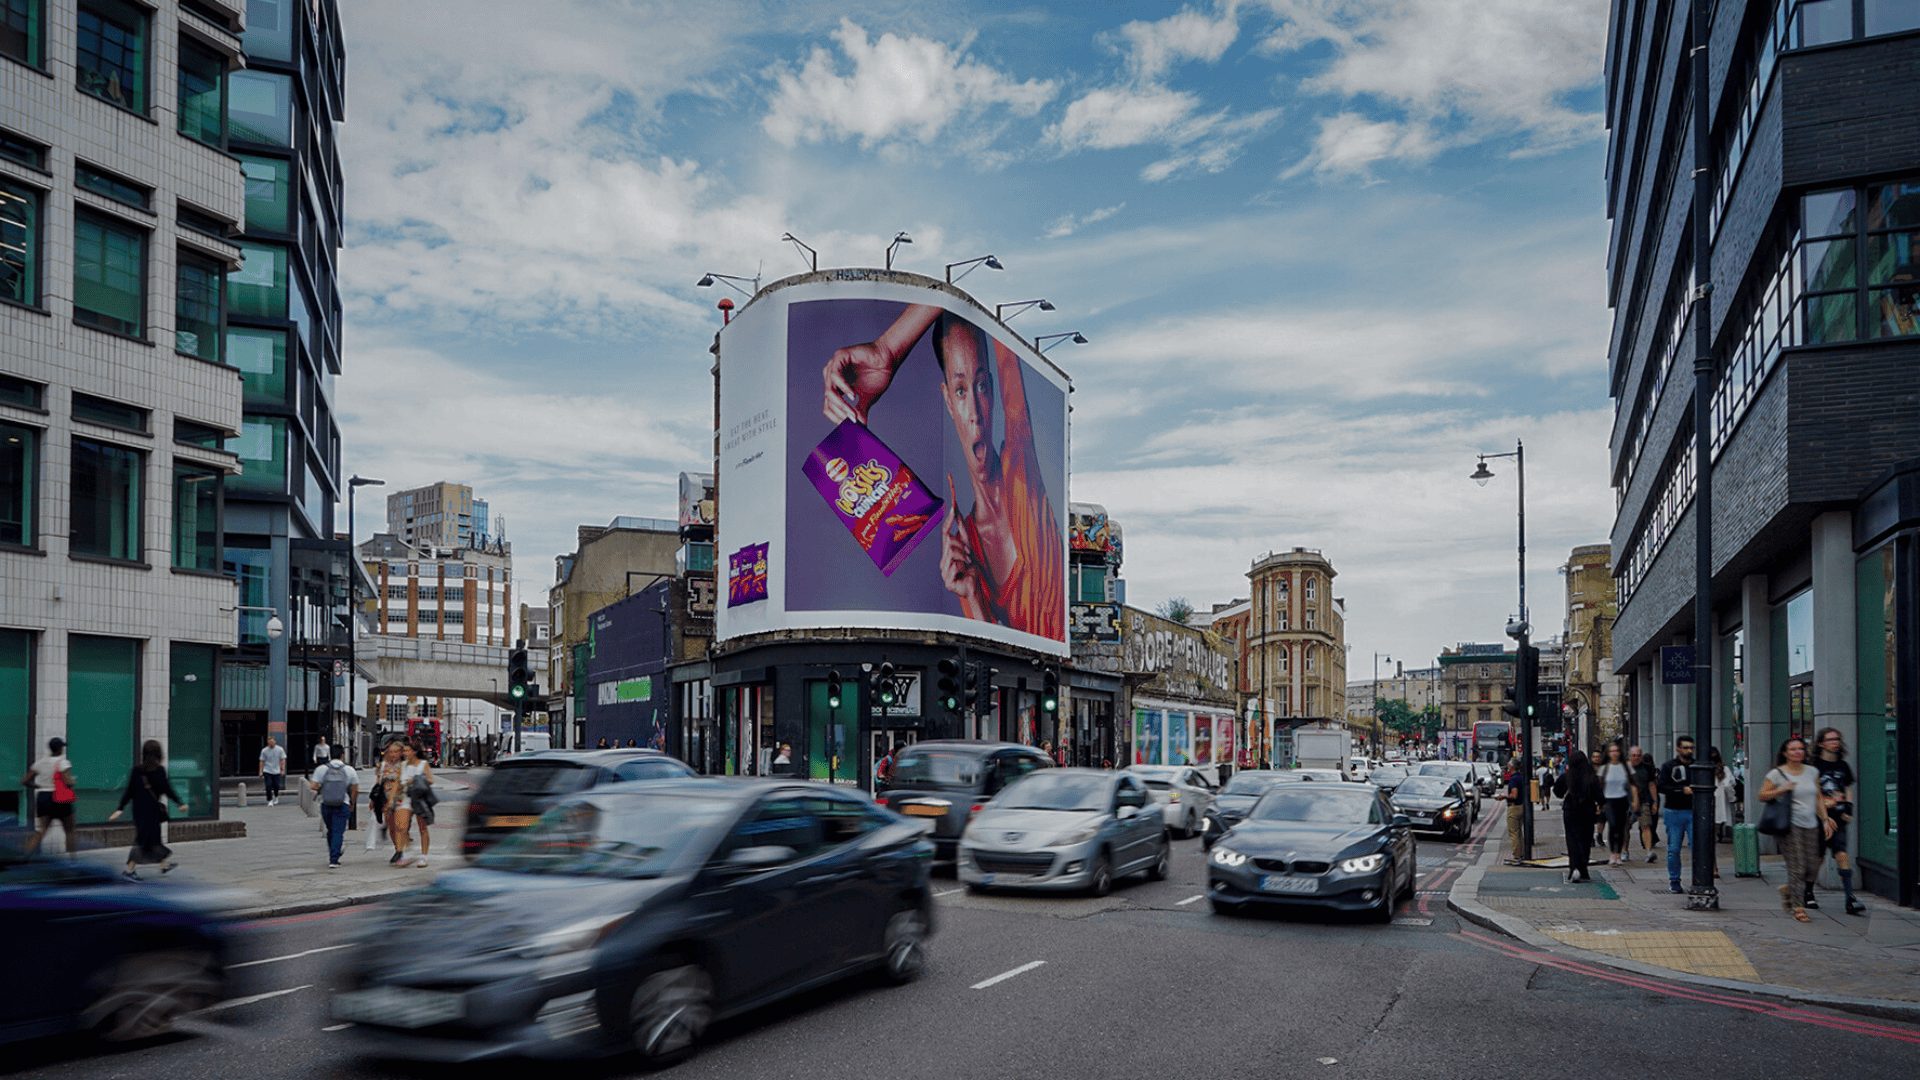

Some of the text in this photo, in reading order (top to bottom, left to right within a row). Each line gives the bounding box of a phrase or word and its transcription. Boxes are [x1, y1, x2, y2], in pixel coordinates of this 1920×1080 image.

[742, 429, 757, 441] WITH
[758, 418, 776, 433] STYLE
[753, 409, 768, 424] HEAT
[853, 483, 890, 518] CRUNCHY
[1124, 630, 1173, 672] ADORE
[1185, 636, 1229, 690] ENDURE
